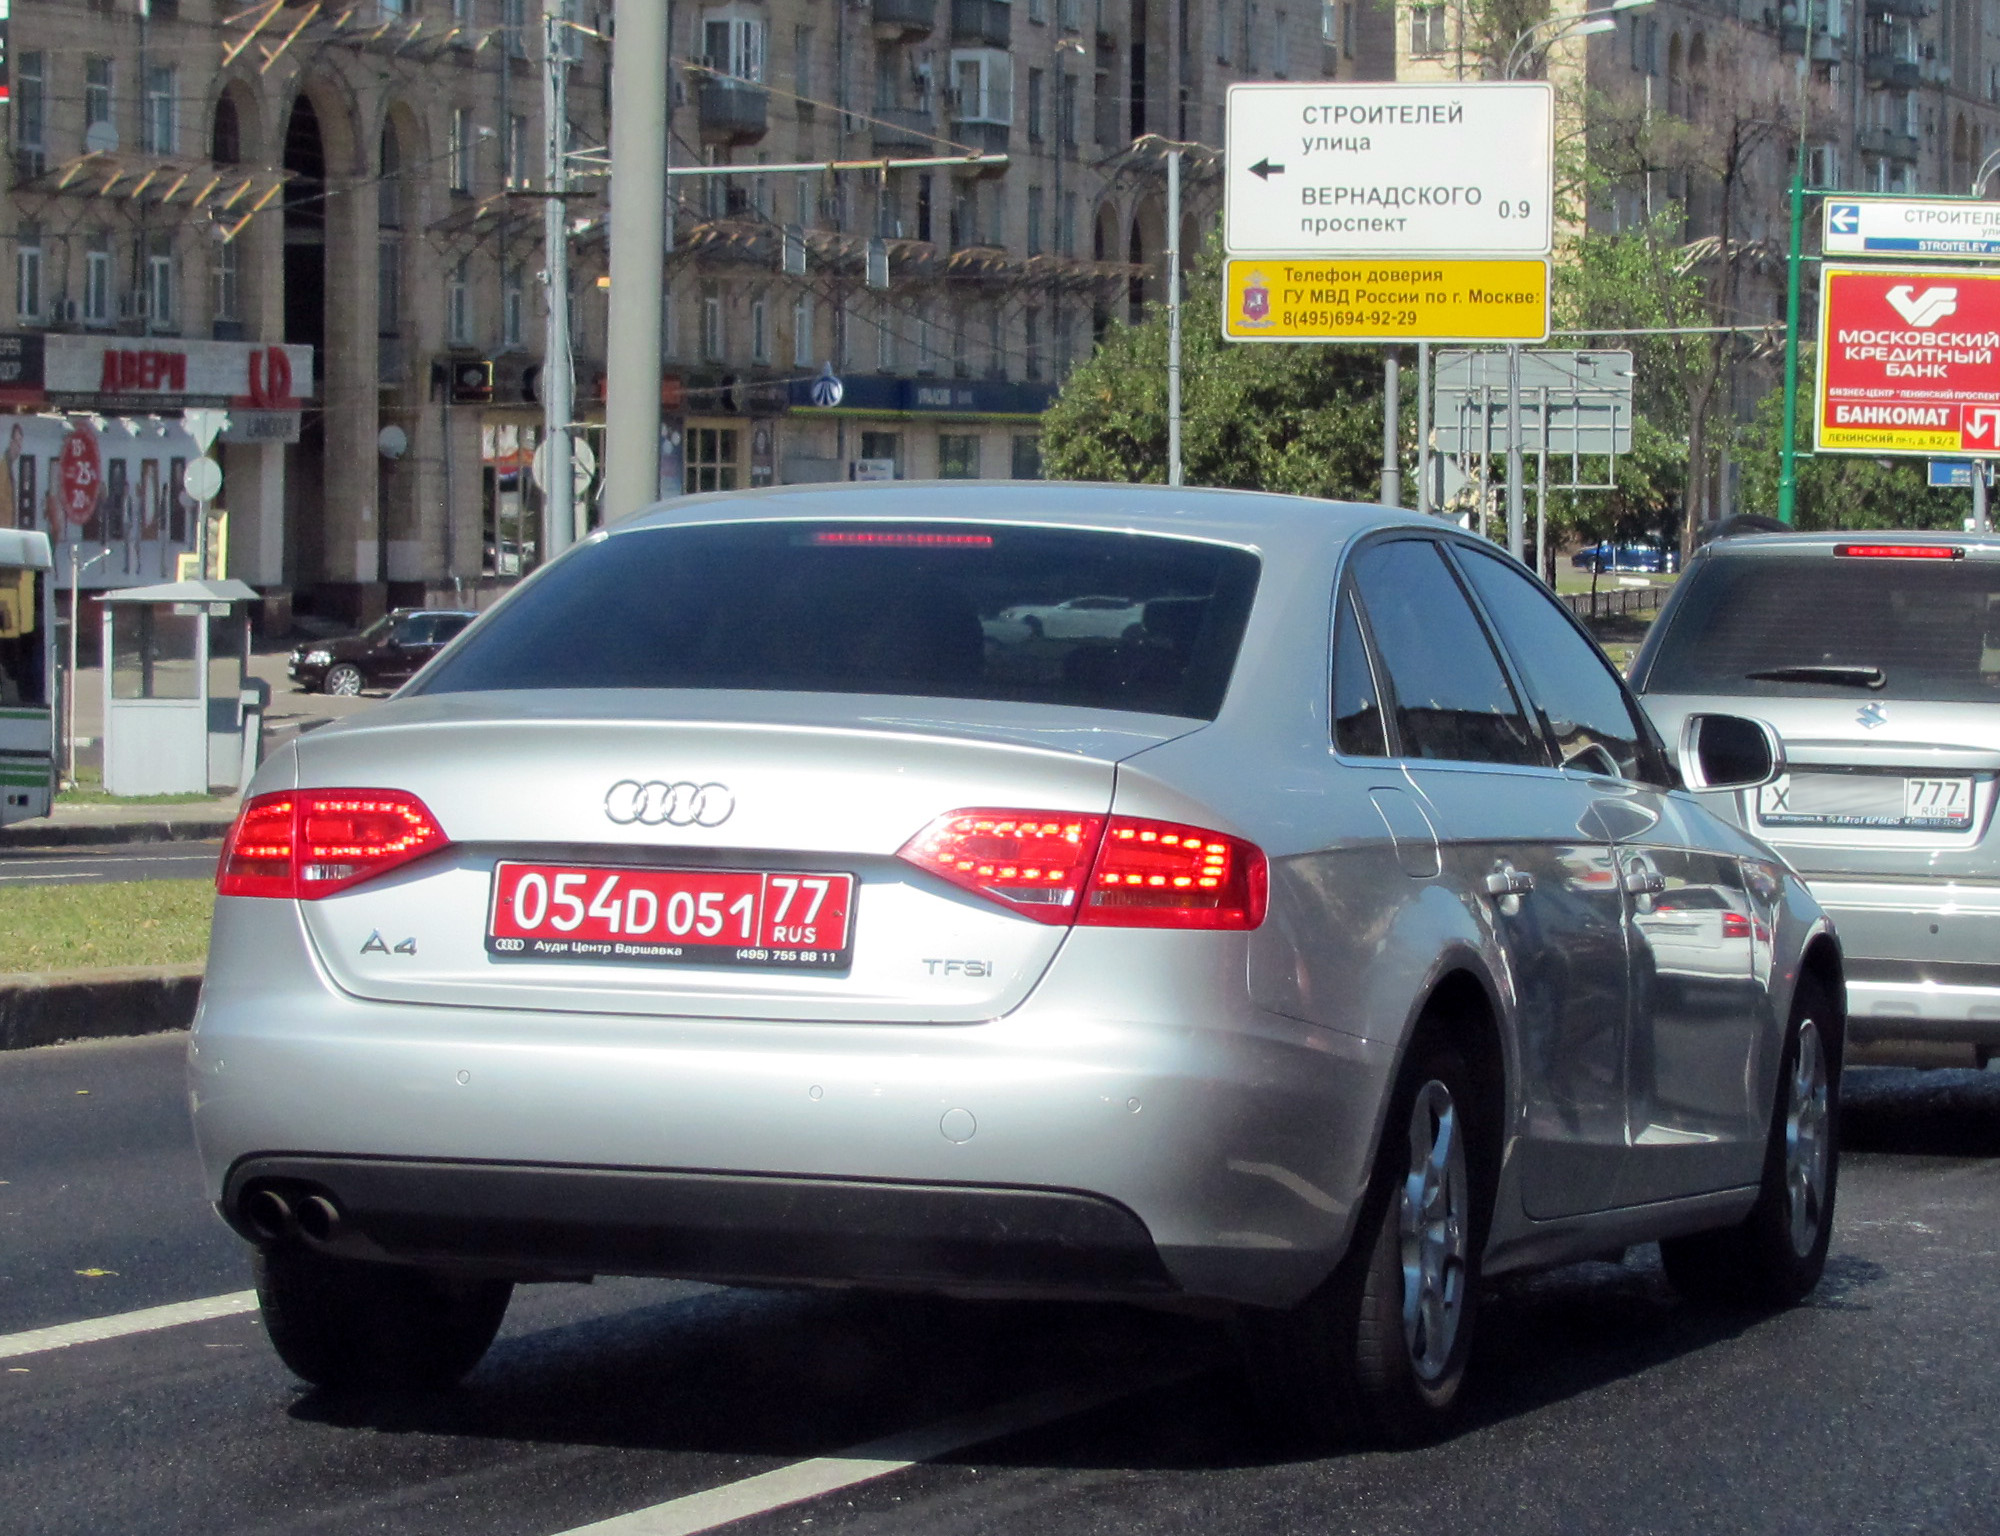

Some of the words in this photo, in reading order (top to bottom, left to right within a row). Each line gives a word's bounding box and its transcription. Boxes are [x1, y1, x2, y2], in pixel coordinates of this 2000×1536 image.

[1303, 101, 1464, 124] СТРОИТЕЛЕЙ
[1302, 136, 1371, 155] улица
[1302, 186, 1482, 209] ВЕРНАДСКОГО
[1498, 200, 1531, 219] 0.9
[1301, 217, 1407, 236] проспект
[1918, 241, 1988, 252] STROITELEY
[1283, 267, 1362, 285] Телефон
[1366, 270, 1443, 285] доверия
[1283, 289, 1304, 304] ГУ
[1310, 289, 1350, 306] МВД
[1355, 289, 1419, 304] России
[1425, 292, 1447, 304] по
[1452, 292, 1463, 304] г.
[1468, 289, 1540, 304] Москве:
[1283, 310, 1417, 330] 8(495)694-92-29
[1838, 329, 2000, 348] МОСКОВСКИЙ
[1845, 346, 1992, 364] КРЕДИТНЫЙ
[101, 349, 187, 392] ДВЕРИ
[1886, 363, 1949, 378] БАНК
[1829, 387, 1895, 398] БИЗНЕС-ЦЕНТР
[1836, 405, 1950, 426] БАНКОМАТ
[1827, 432, 1894, 444] ЛЕНИНСКИЙ
[1911, 780, 1960, 806] 777
[1921, 806, 1946, 817] RUS
[772, 878, 829, 925] 77
[360, 927, 417, 956] A4
[773, 926, 817, 944] RUS
[534, 940, 568, 954] Ауди
[572, 942, 612, 955] Центр
[615, 943, 683, 956] Варшавка
[736, 949, 768, 961] (495)
[822, 952, 836, 962] 11
[922, 958, 993, 978] TFSI
